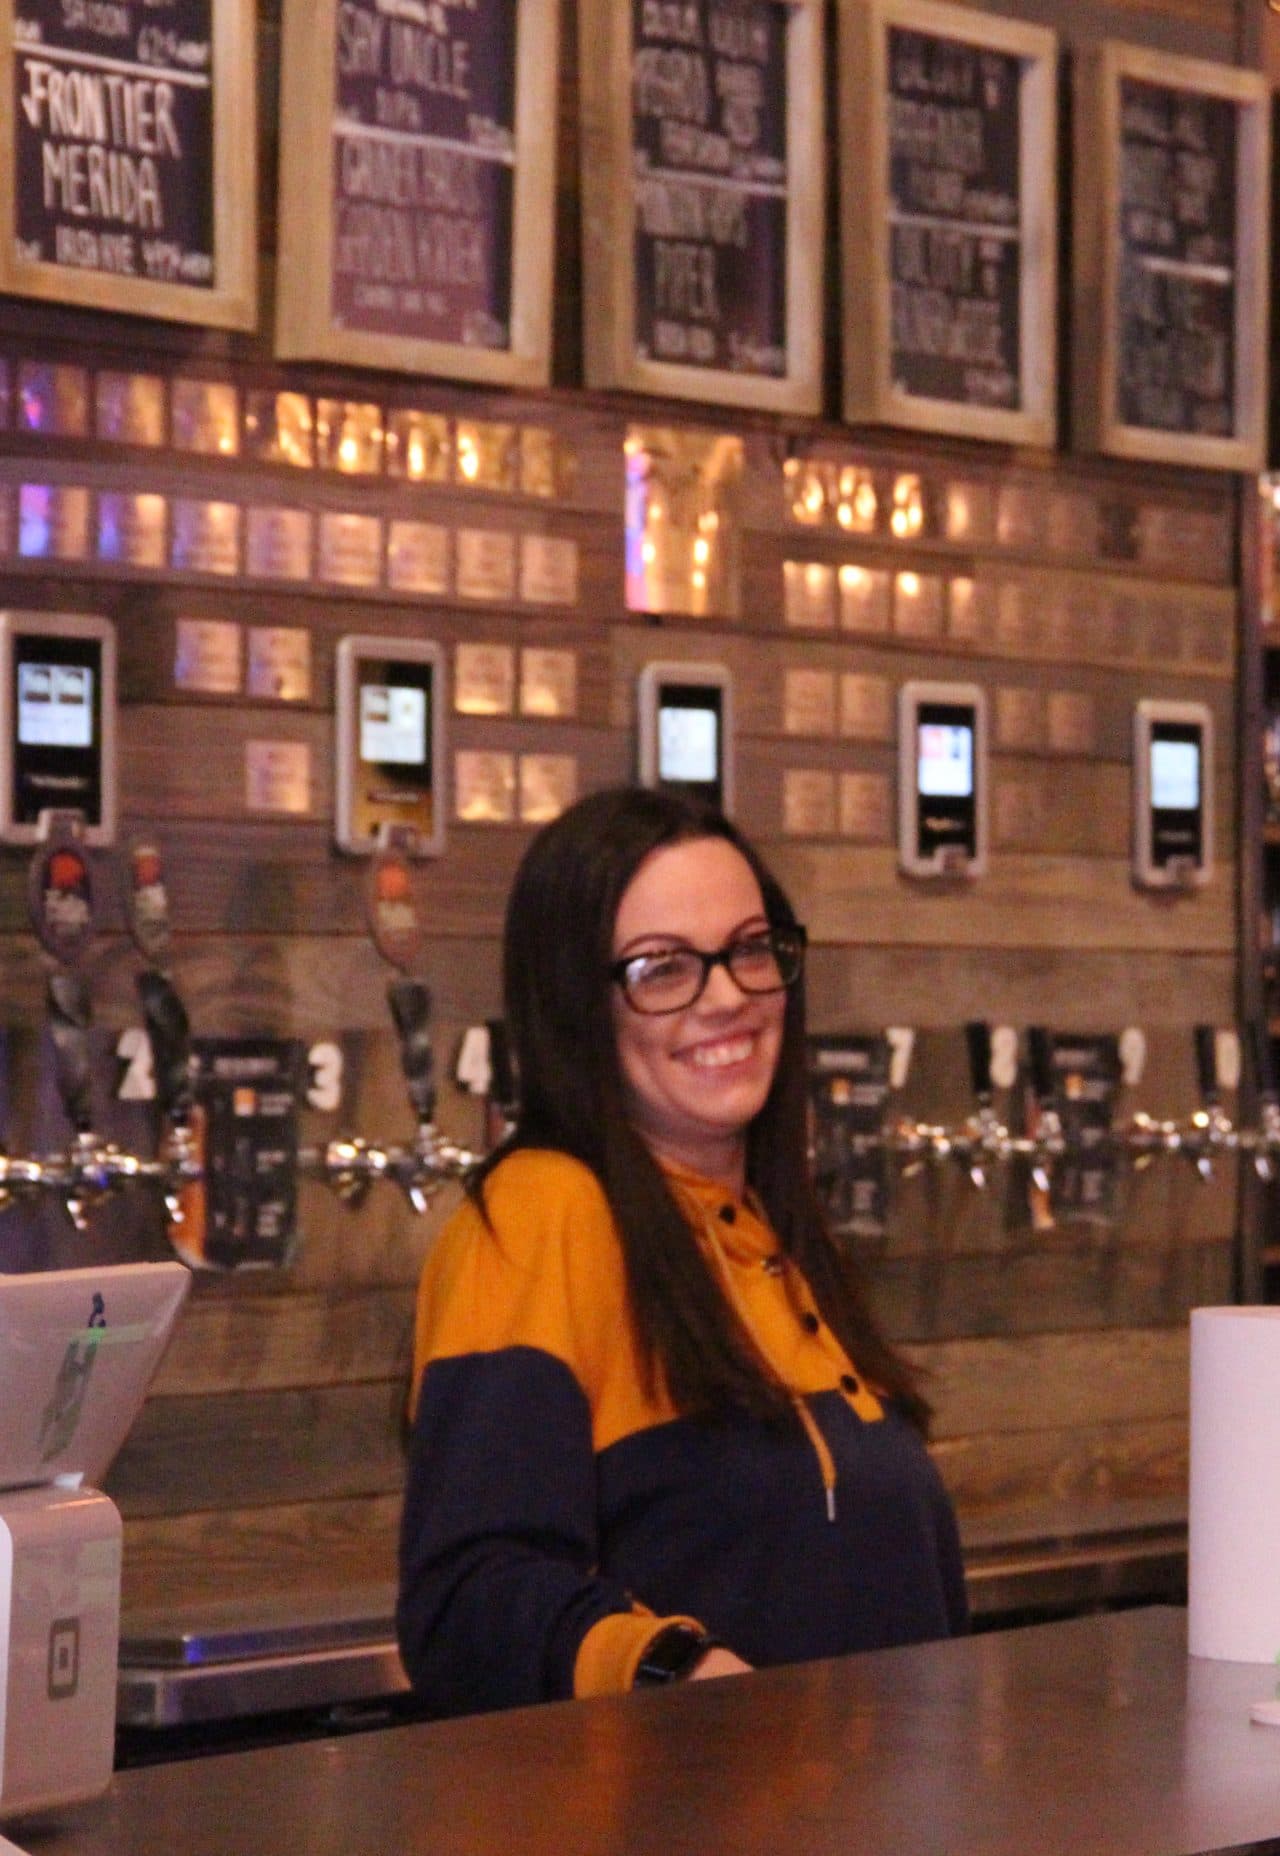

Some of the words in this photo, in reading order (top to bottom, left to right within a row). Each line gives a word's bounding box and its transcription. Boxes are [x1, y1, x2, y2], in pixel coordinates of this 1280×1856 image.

[21, 58, 183, 160] FRONTIER
[43, 140, 164, 230] MERIDA
[115, 1027, 157, 1100] 2
[306, 1042, 344, 1111] 3
[456, 1026, 492, 1095] 4
[886, 1026, 915, 1088] 7
[989, 1026, 1018, 1088] 8
